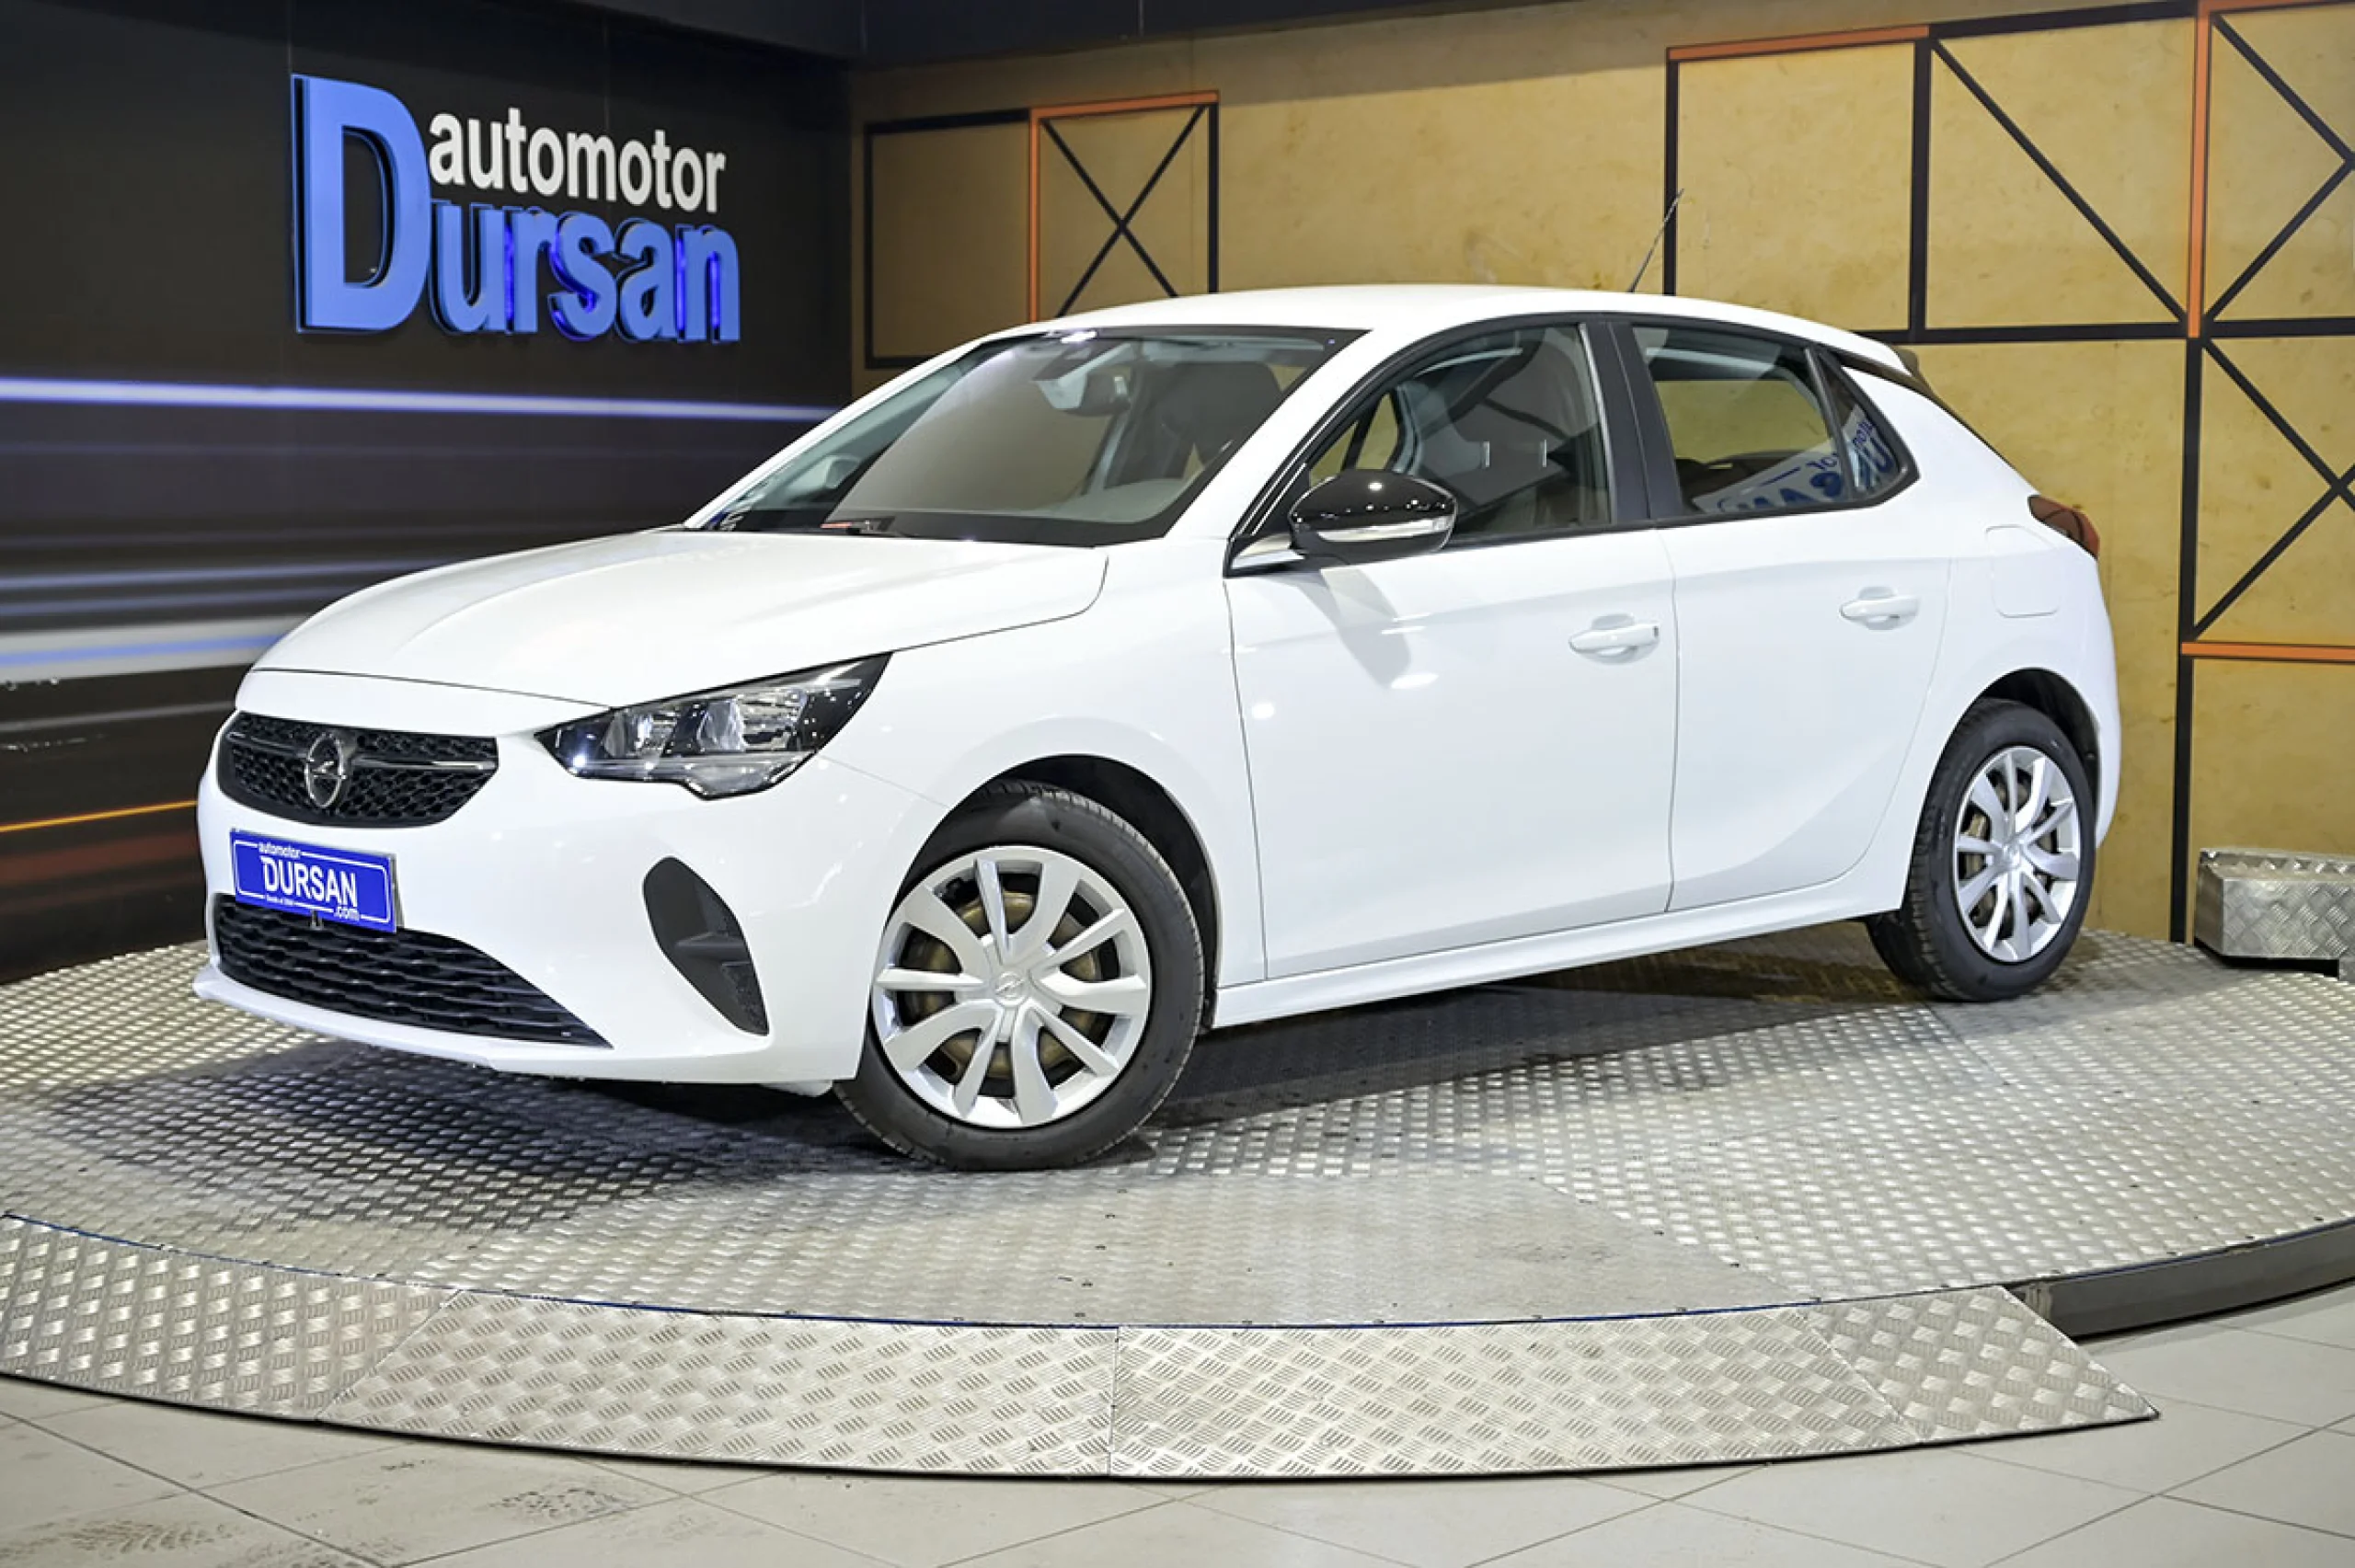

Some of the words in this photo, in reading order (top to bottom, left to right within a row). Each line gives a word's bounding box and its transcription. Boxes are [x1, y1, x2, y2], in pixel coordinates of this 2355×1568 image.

[429, 107, 726, 213] automotor
[292, 73, 741, 344] Dursan
[258, 841, 301, 858] automotor
[260, 856, 357, 907] DURSAN
